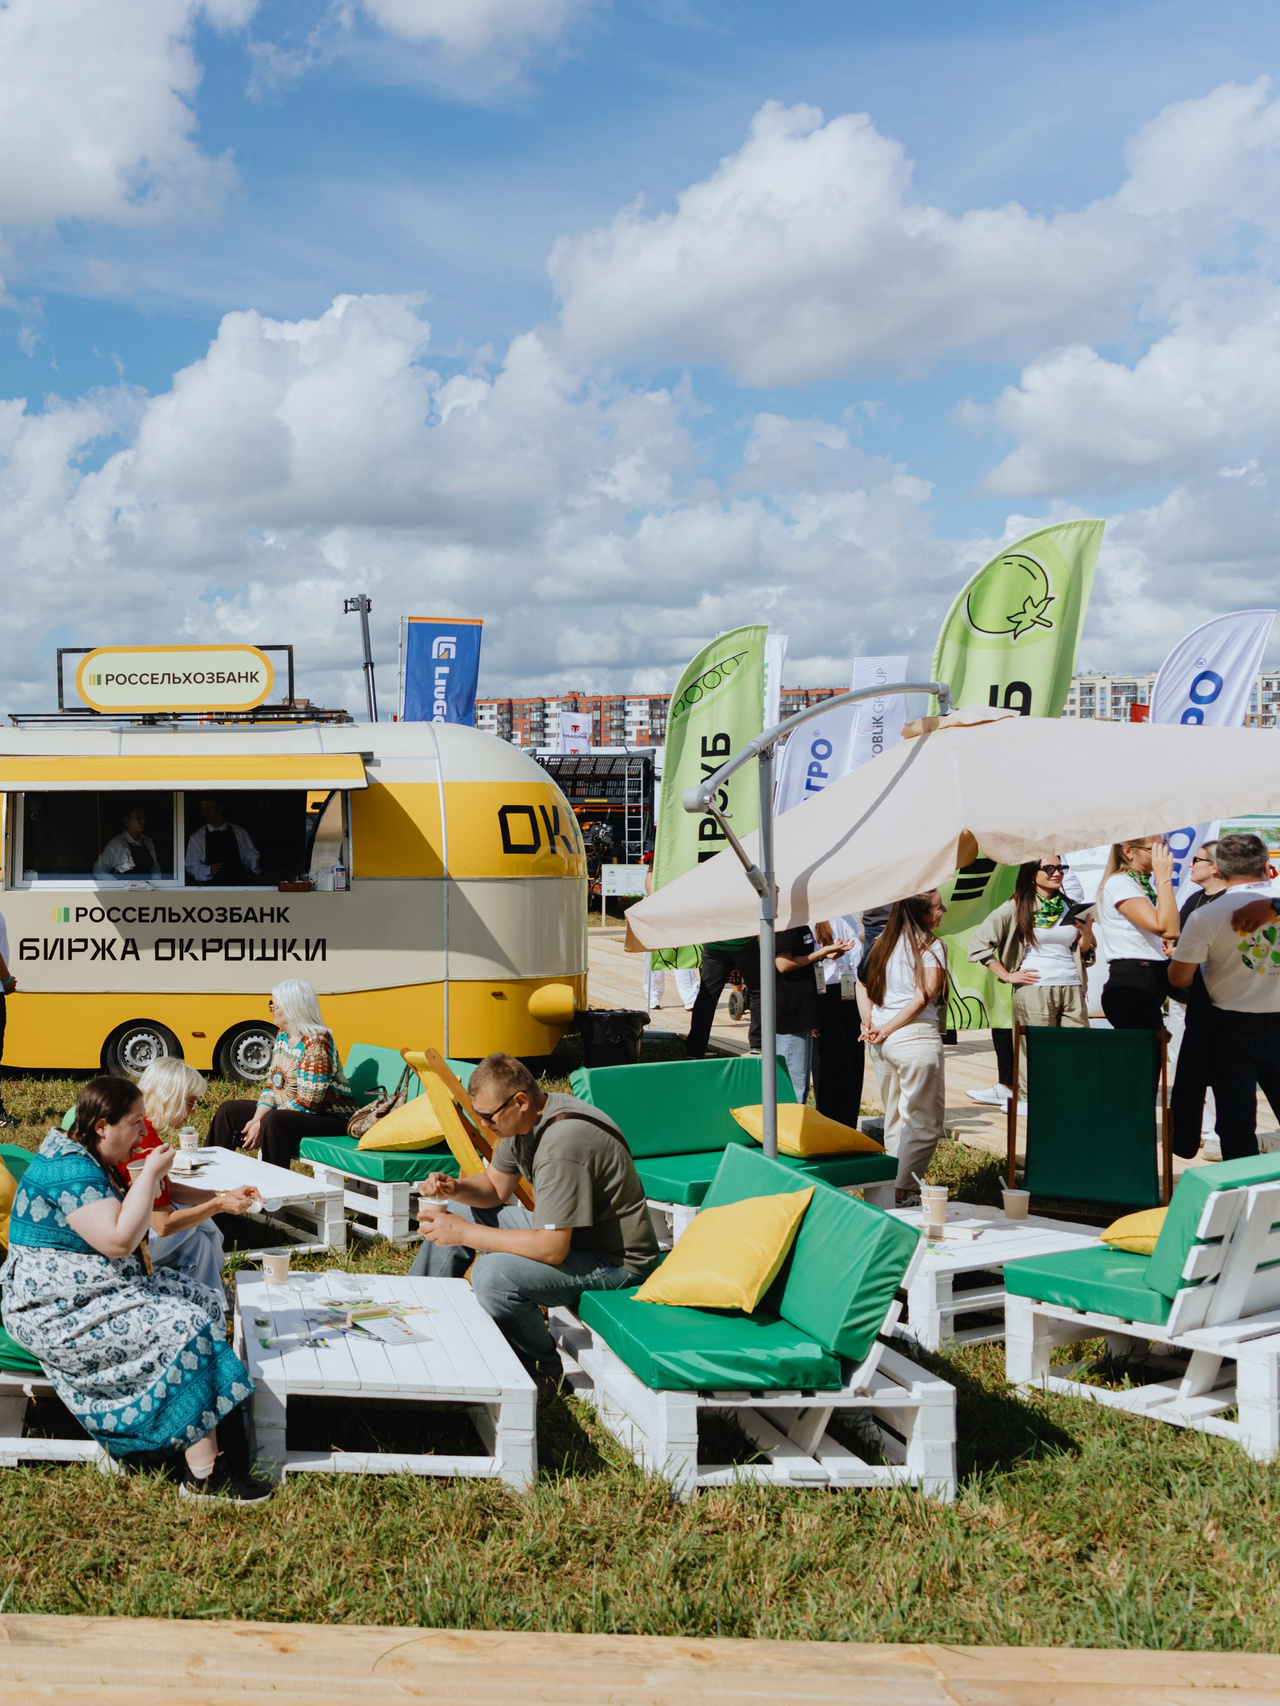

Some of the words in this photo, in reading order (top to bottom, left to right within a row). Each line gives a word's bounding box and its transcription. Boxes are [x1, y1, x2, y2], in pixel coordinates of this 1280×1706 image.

[105, 671, 260, 685] РОССЕЛЬХОЗБАНК
[873, 668, 888, 714] GRUP
[872, 715, 884, 758] OBLiK
[75, 906, 290, 923] РОССЕЛЬХОЗБАНК
[19, 938, 140, 961] БИРЖА
[154, 938, 327, 962] ОКРОШКИ
